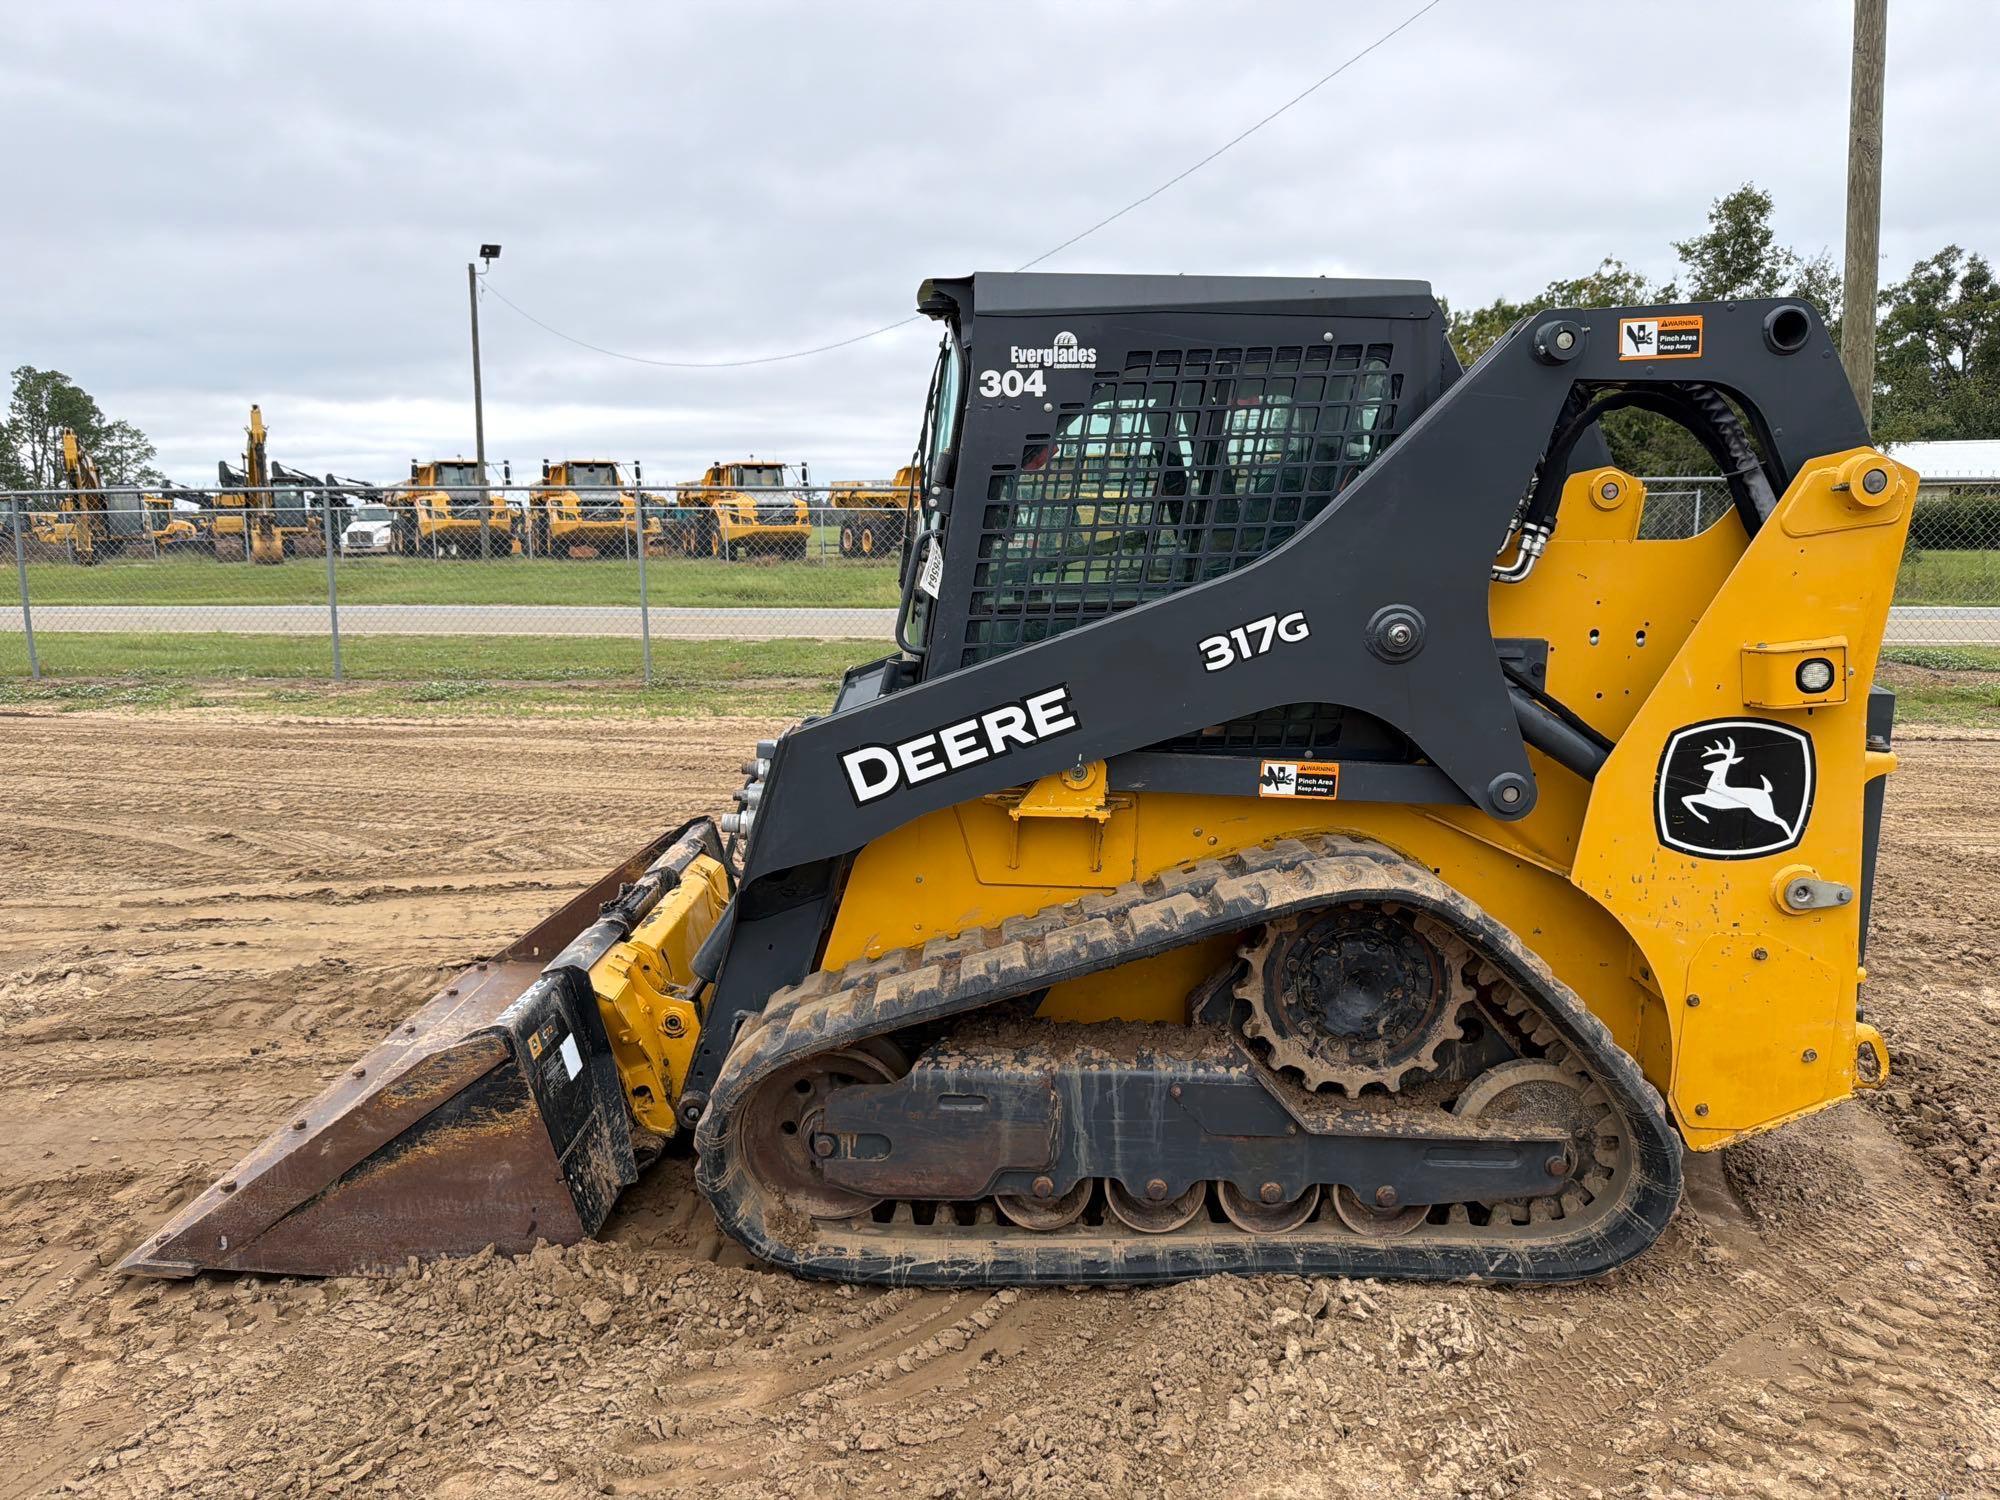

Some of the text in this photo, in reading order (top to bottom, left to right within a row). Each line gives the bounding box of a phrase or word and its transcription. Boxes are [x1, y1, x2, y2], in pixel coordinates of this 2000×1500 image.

[1011, 346, 1097, 367] Everglades
[979, 369, 1047, 398] 304
[1198, 611, 1310, 671] 317G
[843, 686, 1077, 802] DEERE
[1298, 777, 1334, 786] Pinch Area
[1306, 765, 1336, 773] WARNING
